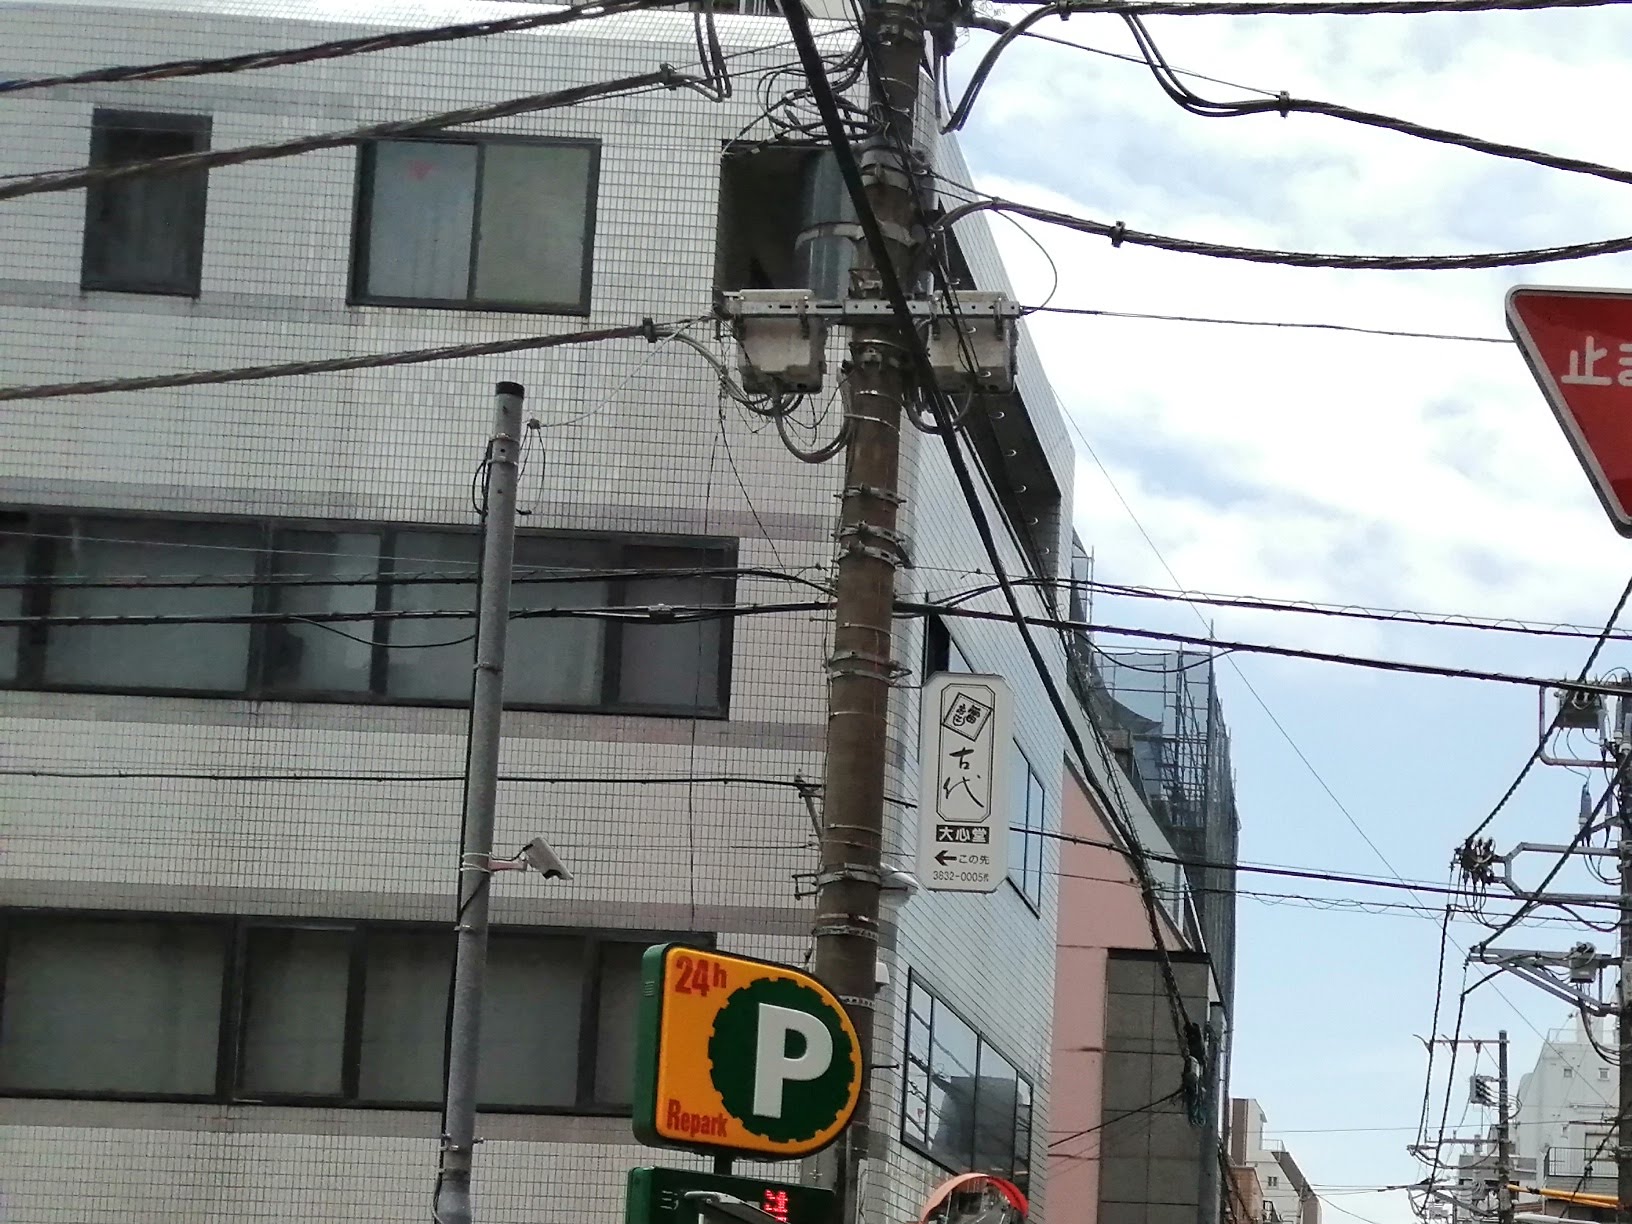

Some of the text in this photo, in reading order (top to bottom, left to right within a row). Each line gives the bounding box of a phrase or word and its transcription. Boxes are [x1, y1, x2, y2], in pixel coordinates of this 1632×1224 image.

[943, 747, 985, 808] 古代
[938, 827, 988, 844] 大心堂
[958, 854, 990, 866] この先
[674, 956, 728, 997] 24h
[753, 1002, 833, 1119] P
[666, 1098, 728, 1138] Repark
